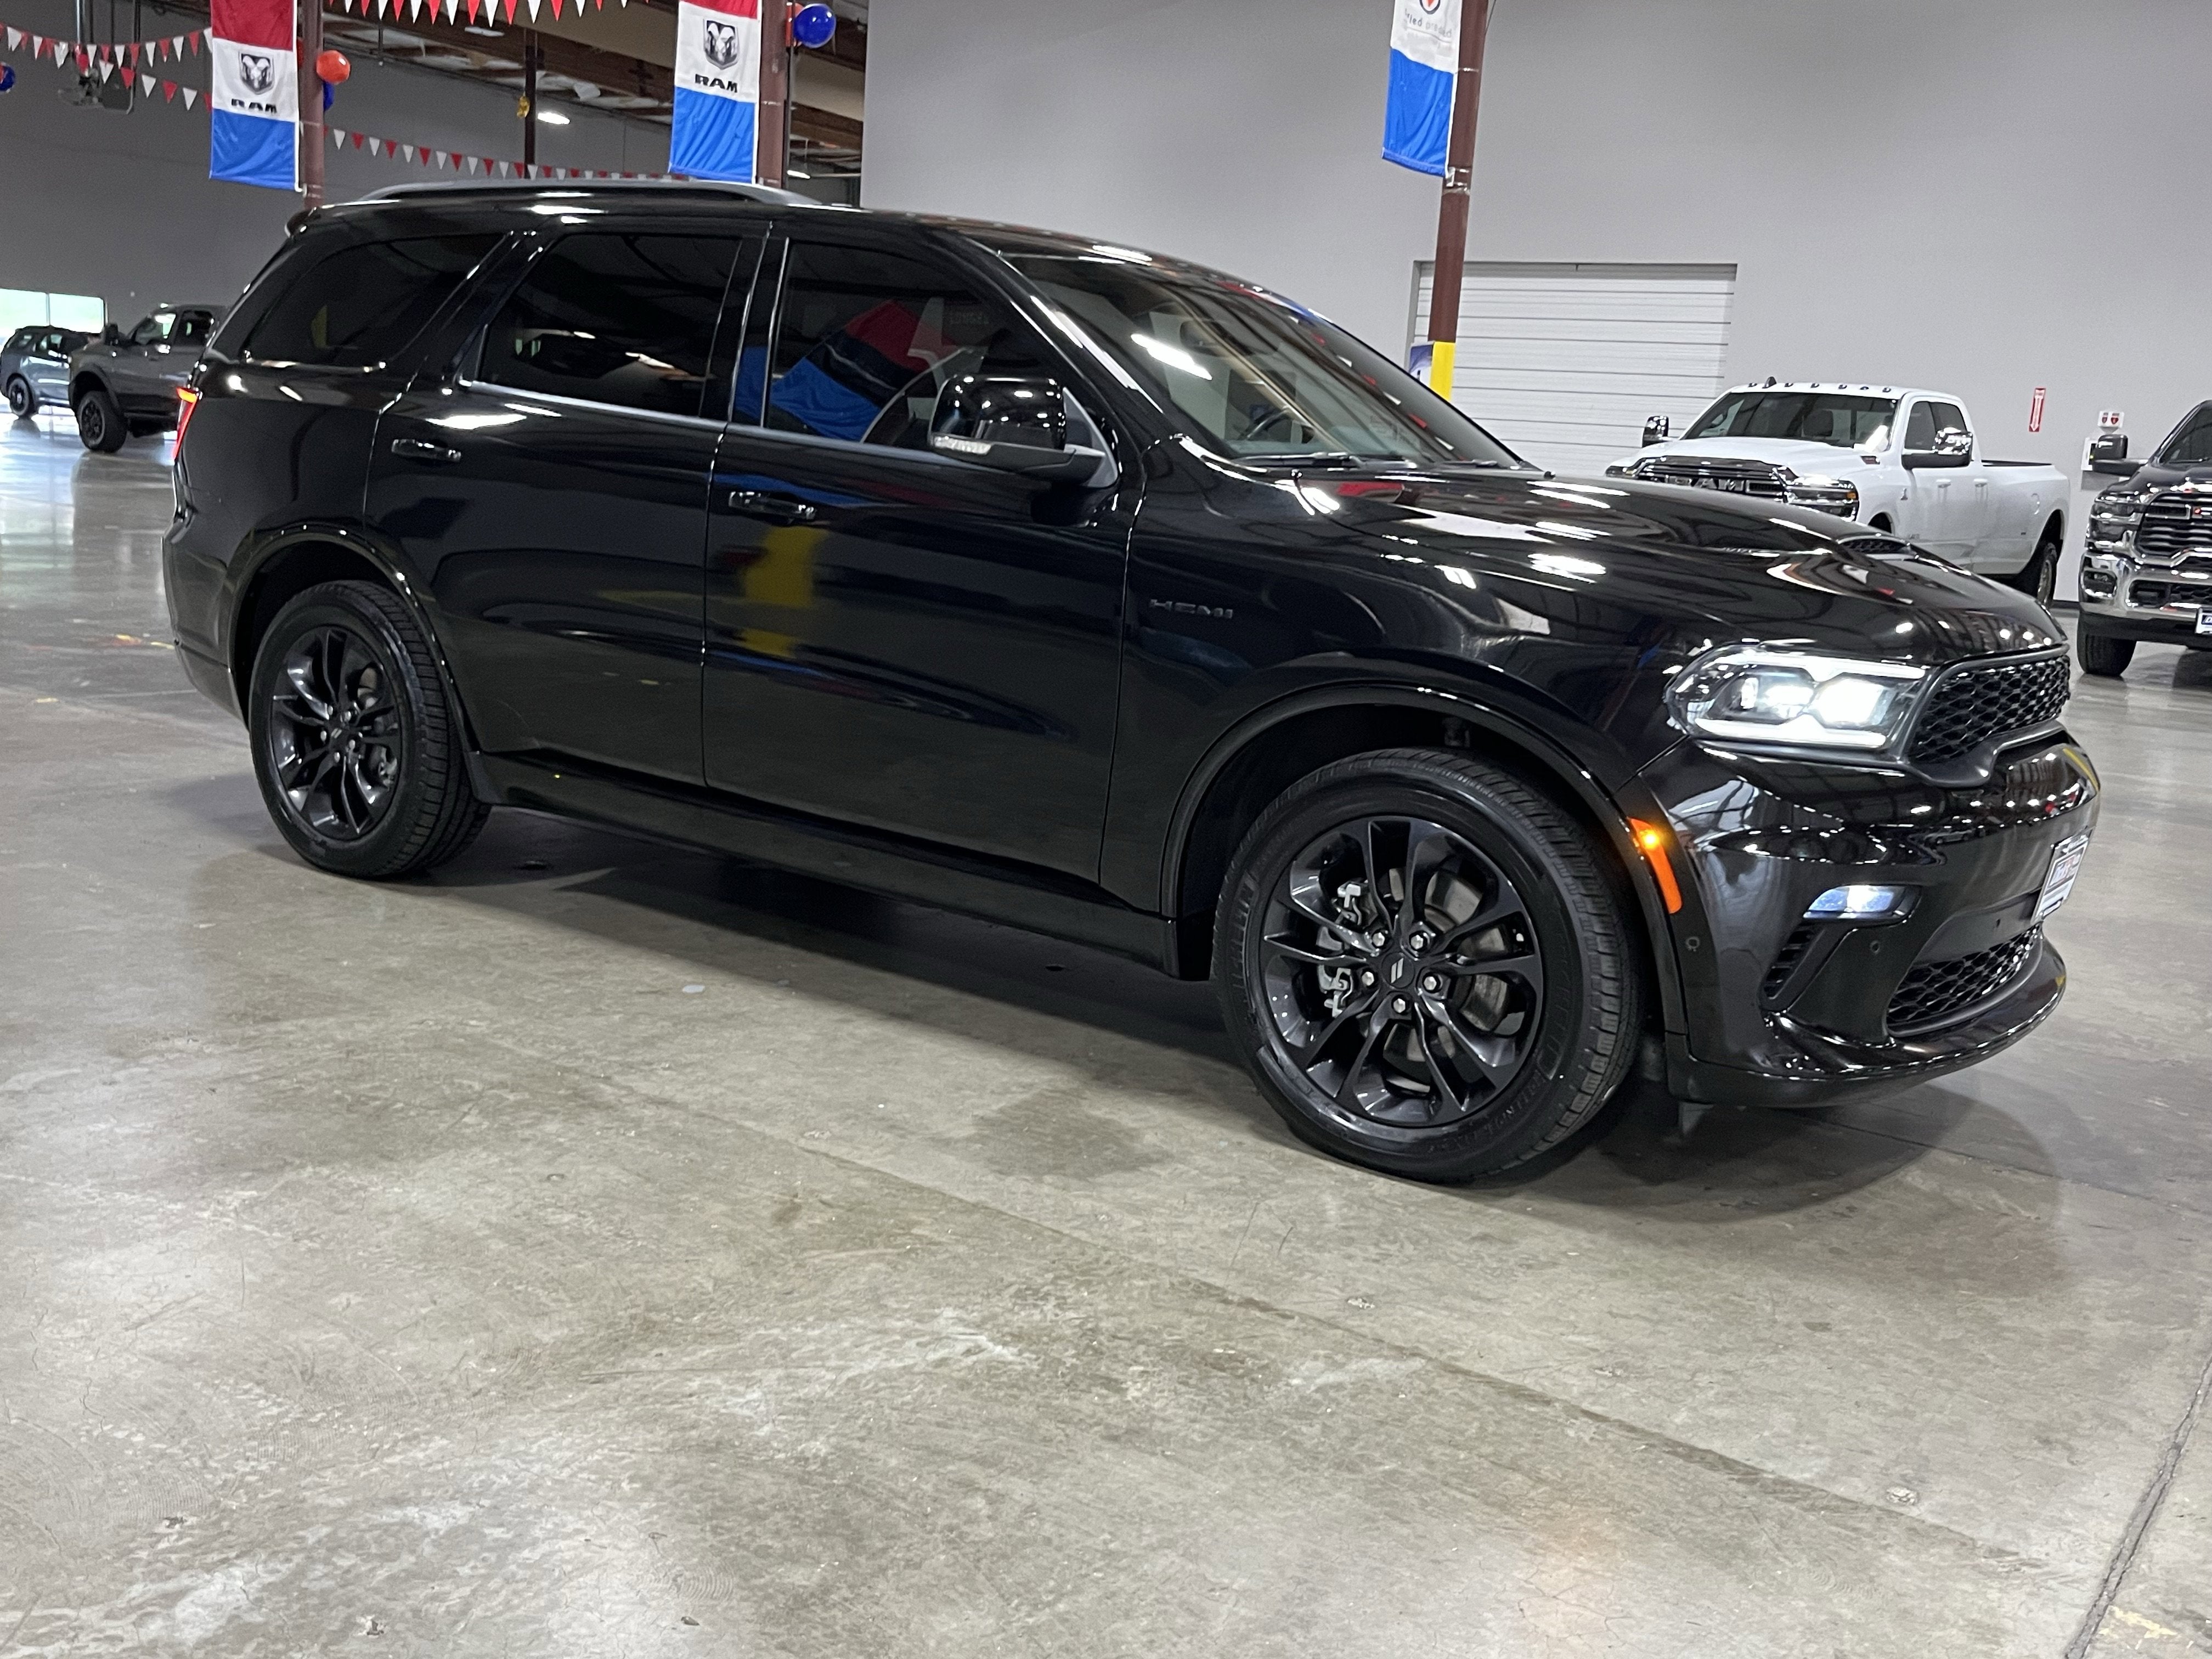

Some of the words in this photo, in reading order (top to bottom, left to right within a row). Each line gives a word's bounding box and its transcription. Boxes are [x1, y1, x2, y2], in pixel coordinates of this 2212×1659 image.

[695, 74, 737, 93] RAM
[231, 98, 277, 114] RAM
[1669, 475, 1745, 492] RAM
[1150, 599, 1233, 619] HEMI
